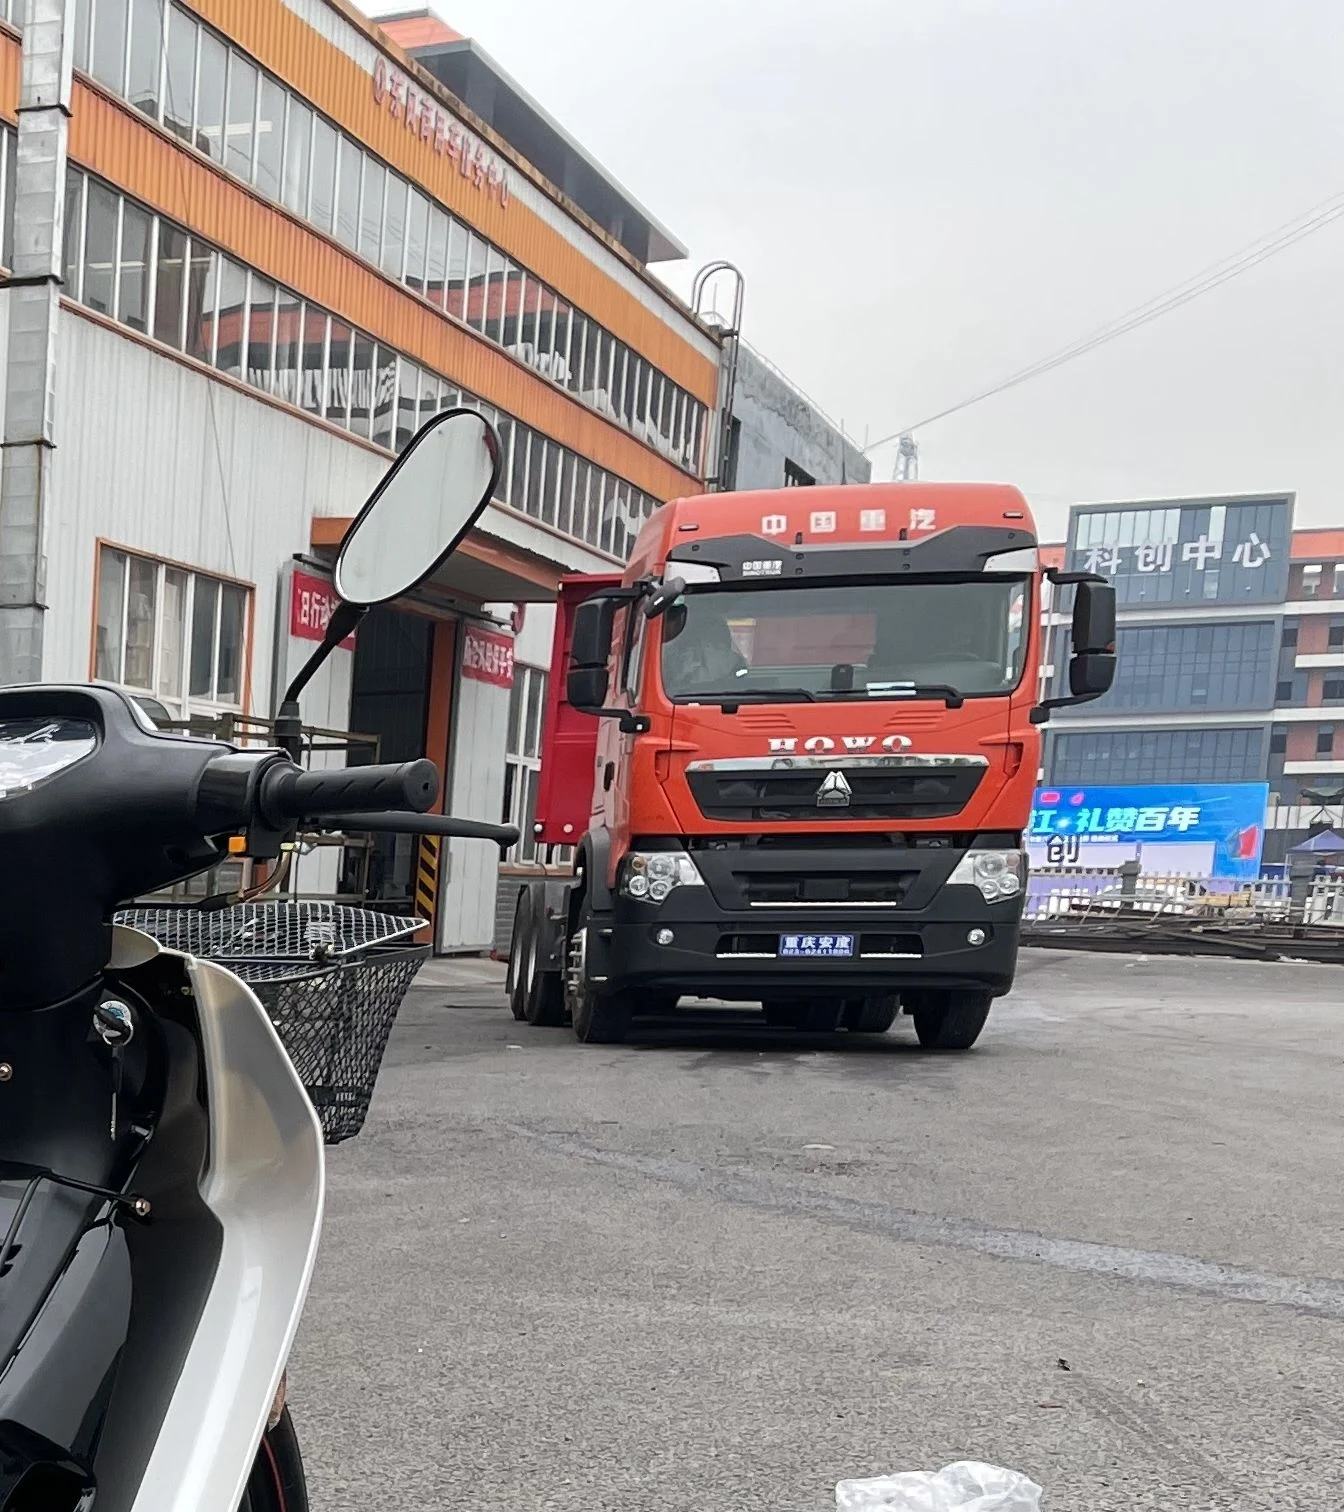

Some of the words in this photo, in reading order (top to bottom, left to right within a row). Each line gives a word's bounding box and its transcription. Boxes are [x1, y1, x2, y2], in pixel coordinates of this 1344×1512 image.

[762, 508, 936, 535] 中国重汽
[1084, 532, 1272, 575] 科创中心
[767, 734, 913, 754] HOWO
[1046, 833, 1080, 863] 创
